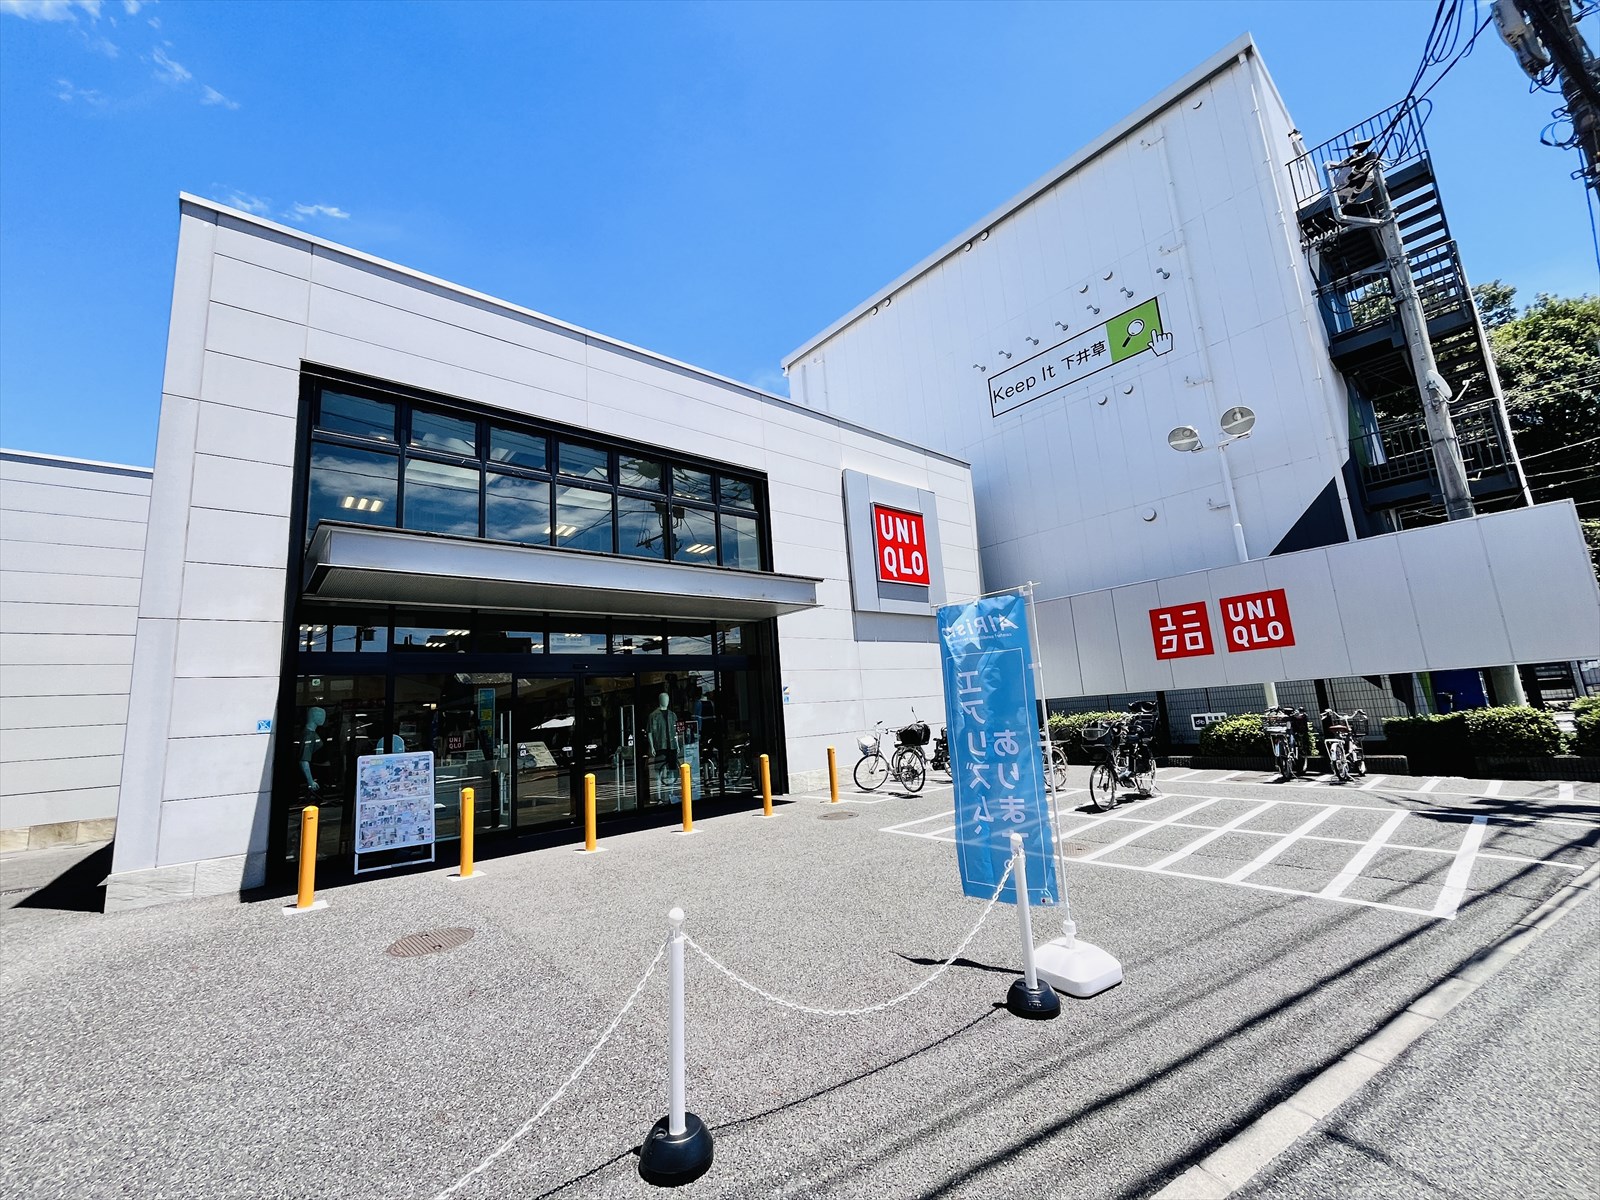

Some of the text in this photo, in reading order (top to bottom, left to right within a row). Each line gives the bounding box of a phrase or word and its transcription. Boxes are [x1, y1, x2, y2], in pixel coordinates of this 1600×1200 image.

[992, 340, 1107, 404] Keep It 下井草
[880, 514, 918, 545] UNI
[883, 546, 924, 577] QLO
[1159, 609, 1201, 632] ユニ
[1227, 597, 1276, 622] UNI
[1161, 631, 1205, 654] クロ
[1232, 620, 1285, 648] QLO
